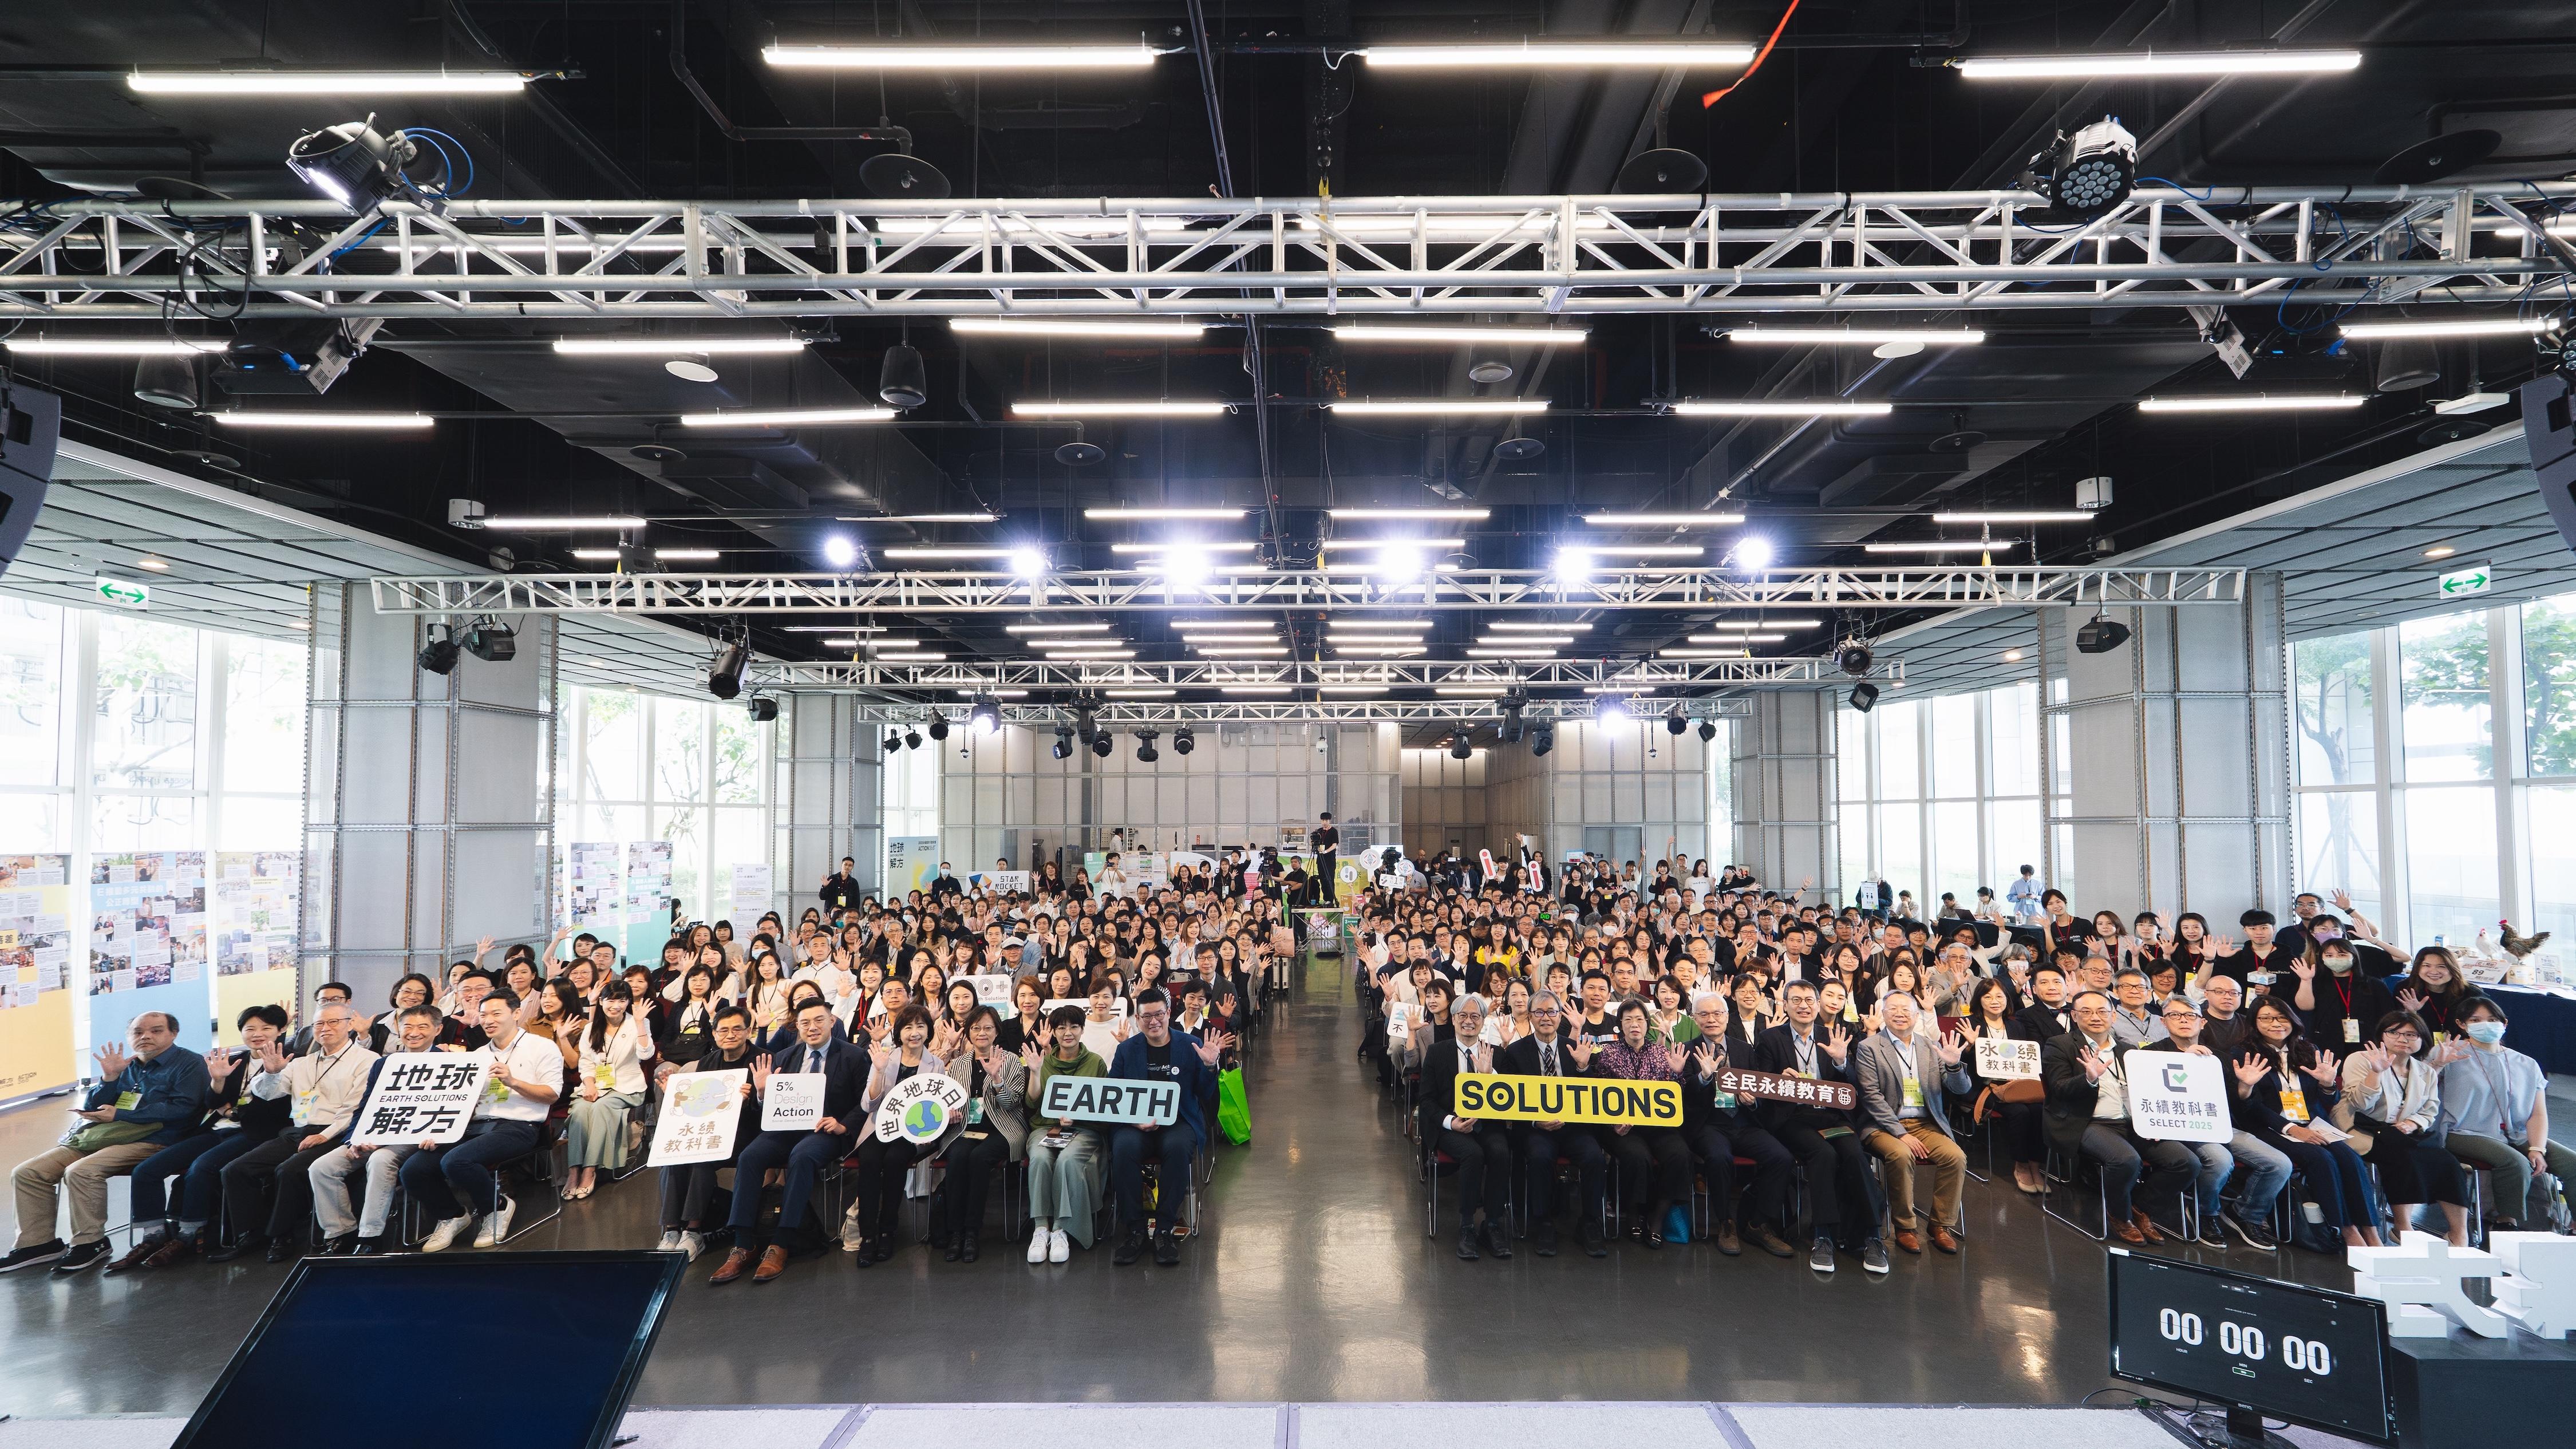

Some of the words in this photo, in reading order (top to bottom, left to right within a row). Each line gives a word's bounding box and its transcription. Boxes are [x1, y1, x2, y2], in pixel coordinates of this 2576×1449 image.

[890, 842, 904, 852] 地球
[890, 858, 903, 868] 解方
[1393, 1024, 1403, 1033] 不
[1980, 1041, 2037, 1061] 永續
[1986, 1059, 2032, 1073] 教科書
[385, 1063, 479, 1091] 地球
[776, 1081, 793, 1091] 5%
[1721, 1071, 1835, 1103] 全民永續教育
[414, 1094, 468, 1102] SOLUTIONS
[775, 1092, 813, 1105] Design
[1048, 1082, 1174, 1118] EARTH
[1461, 1080, 1676, 1119] SOLUTIONS
[773, 1107, 813, 1117] Action
[882, 1079, 961, 1136] 世界地球日
[2141, 1099, 2218, 1117] 永續教科書
[365, 1105, 461, 1135] 解方
[2150, 1118, 2186, 1128] SELECT
[2189, 1121, 2212, 1130] 2025
[678, 1121, 715, 1136] 永續
[664, 1135, 722, 1153] 教科書
[2160, 1308, 2203, 1345] 00
[2220, 1321, 2265, 1360] 00
[2283, 1335, 2331, 1375] 00
[2238, 1403, 2253, 1411] BenQ
